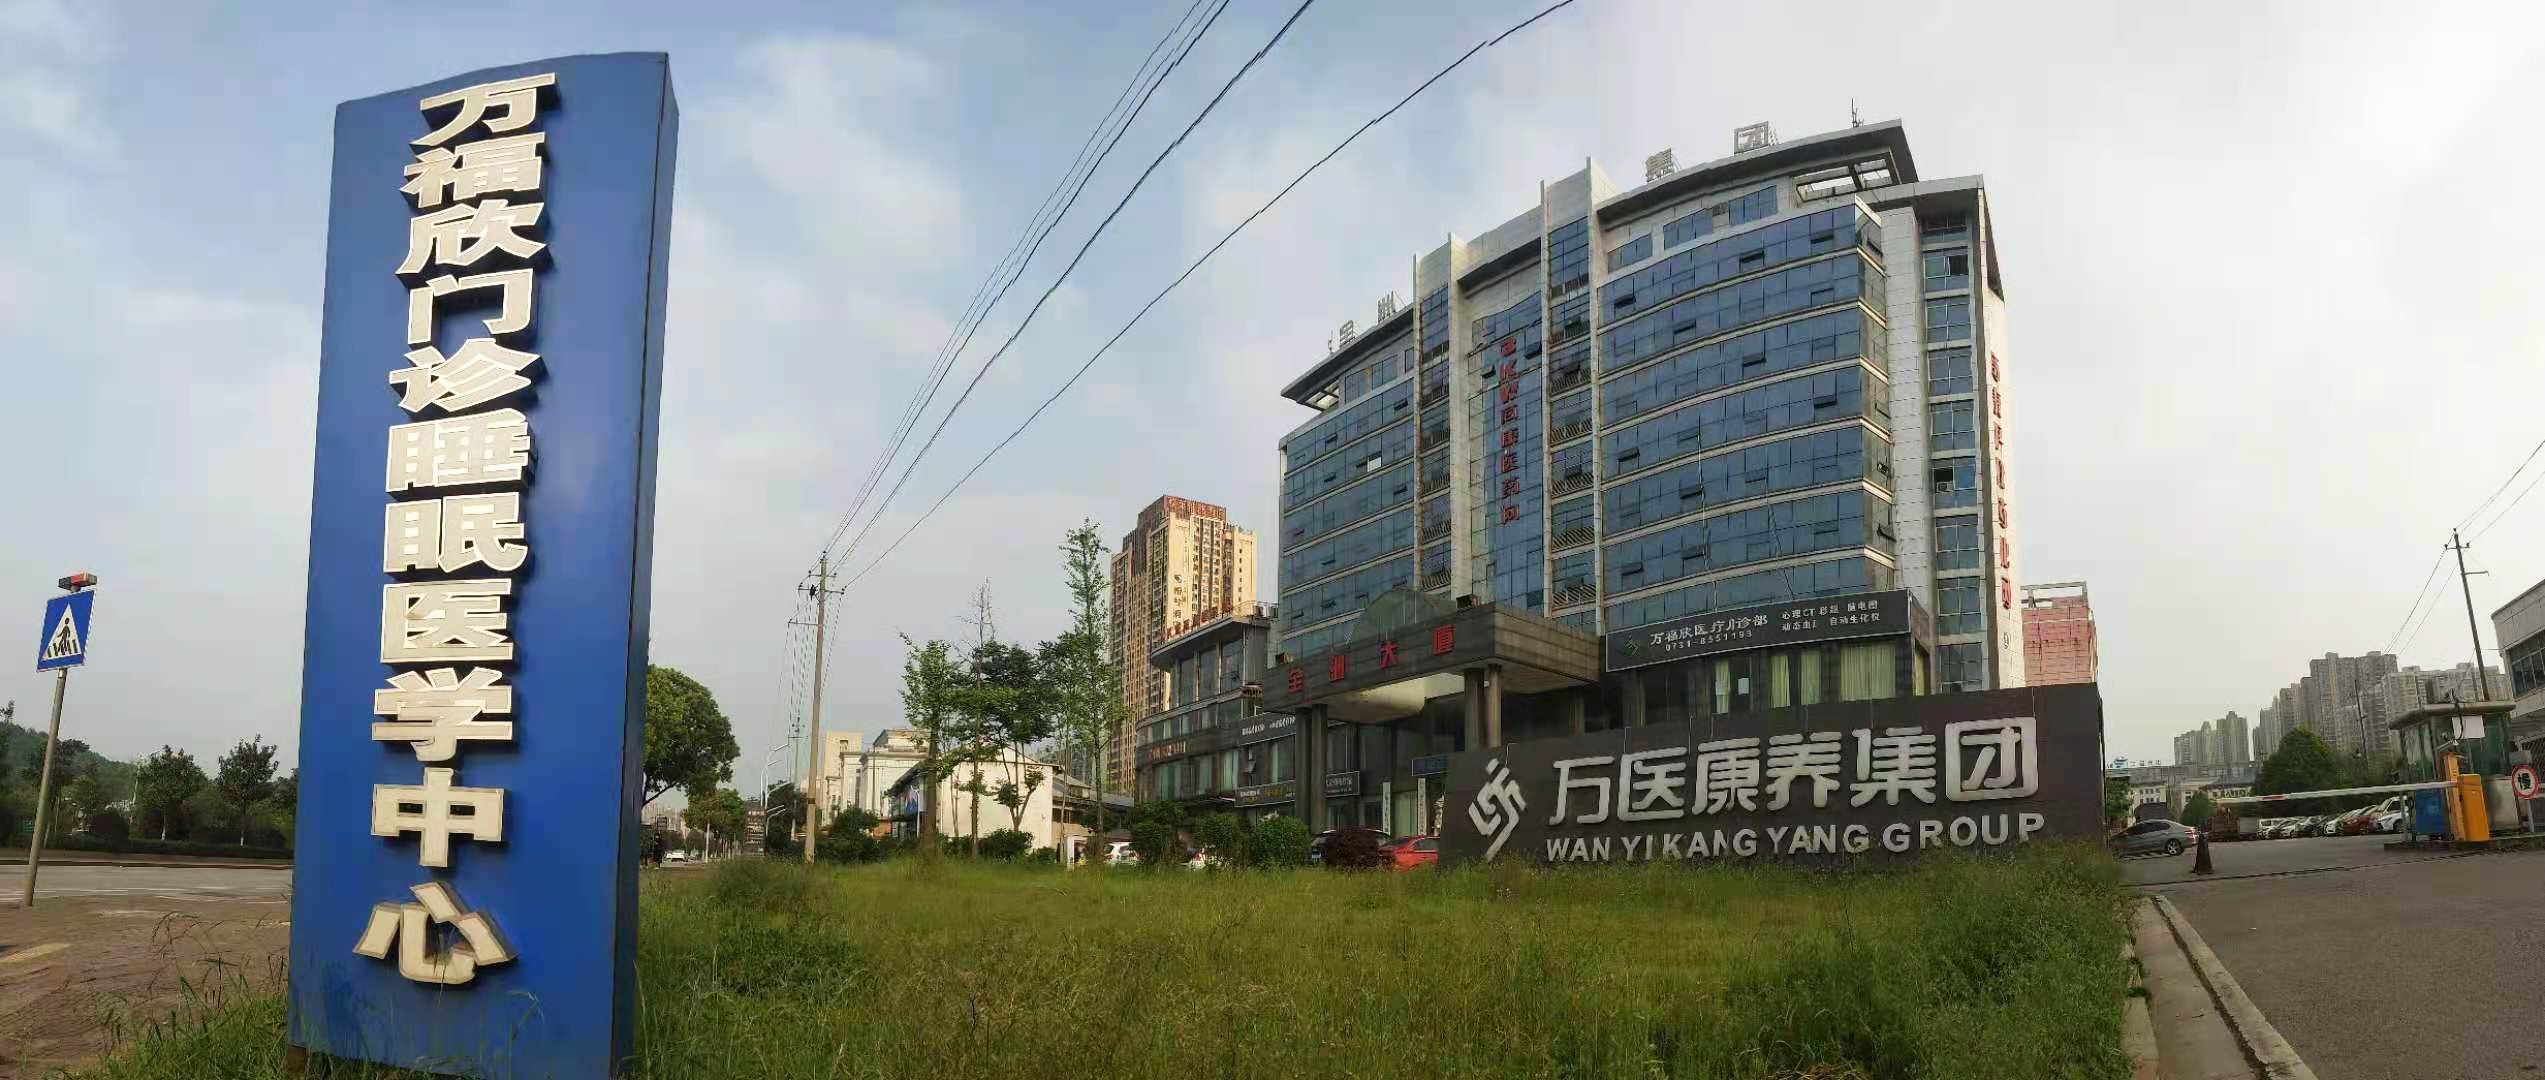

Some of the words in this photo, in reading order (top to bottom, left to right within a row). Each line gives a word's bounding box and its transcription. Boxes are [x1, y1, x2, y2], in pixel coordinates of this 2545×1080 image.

[352, 72, 556, 985] 万福欣门诊睡眠医学中心
[1549, 716, 2040, 826] 万医康养集团
[1546, 836, 1611, 862] WAN
[1663, 828, 1758, 860] KANG
[1766, 824, 1870, 855] YANG
[1882, 812, 2046, 852] GROUP
